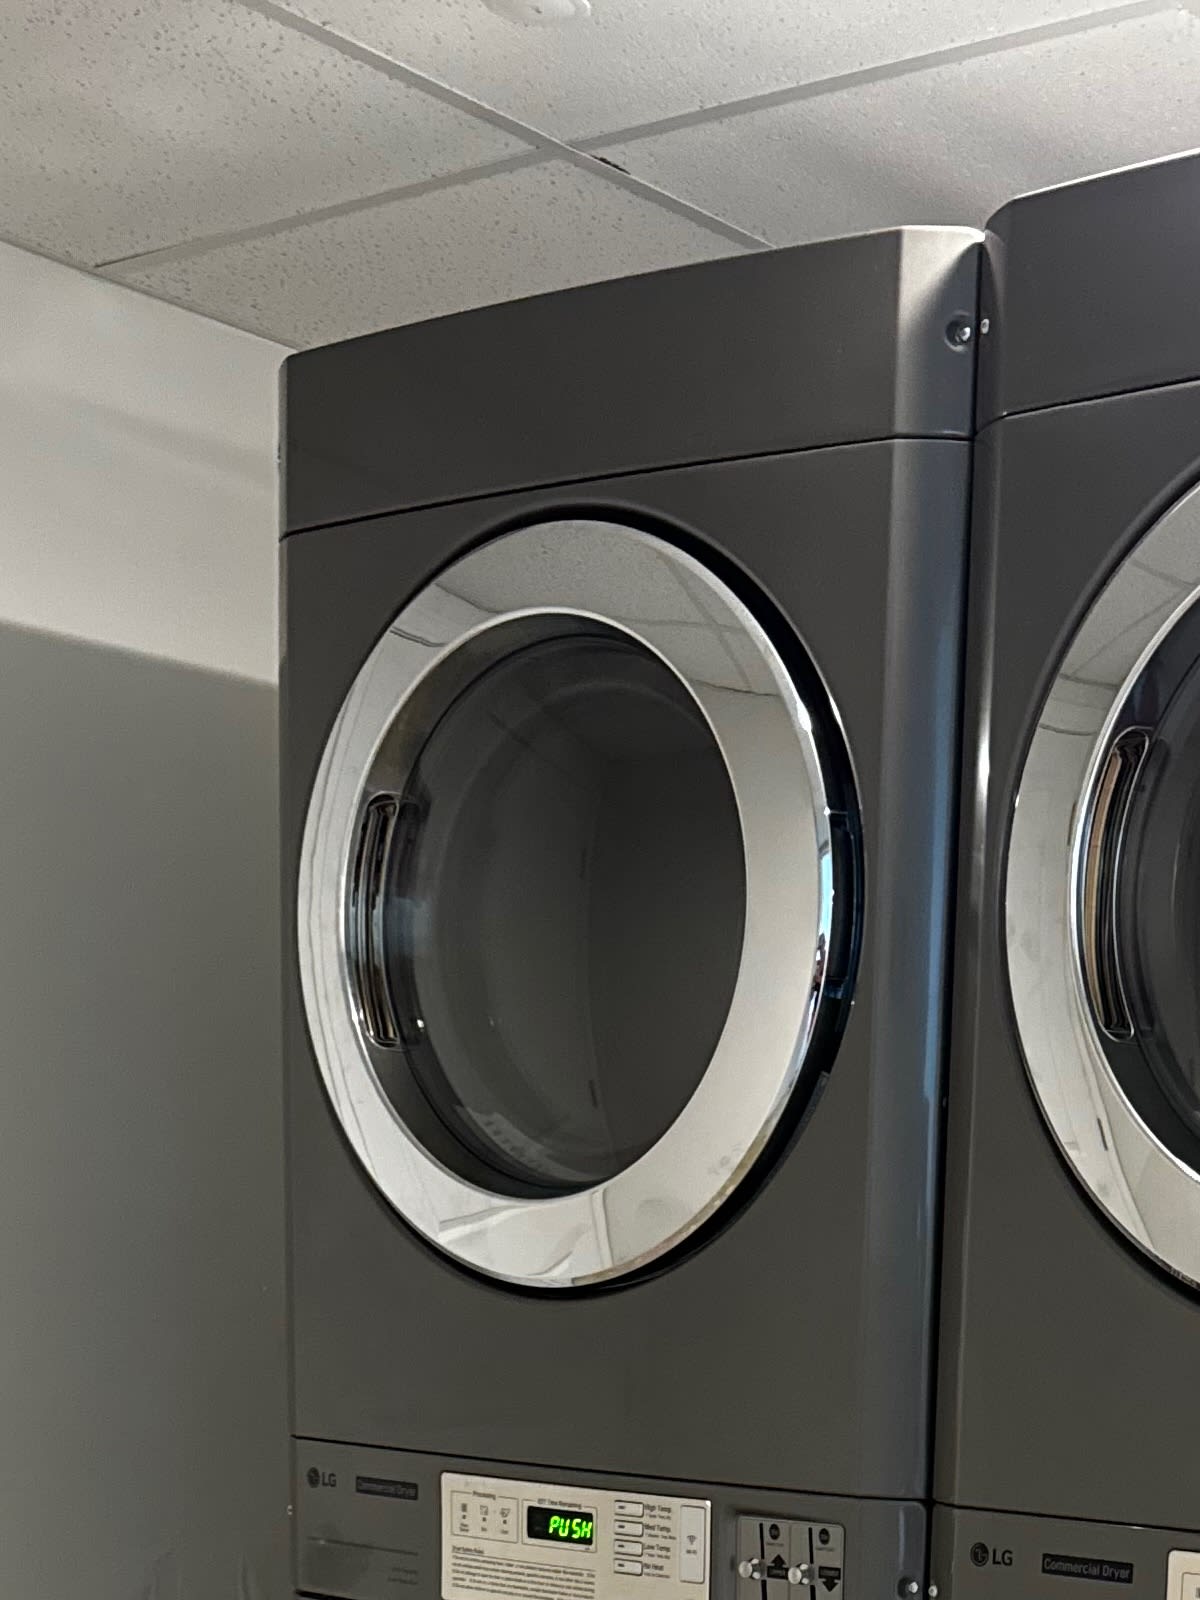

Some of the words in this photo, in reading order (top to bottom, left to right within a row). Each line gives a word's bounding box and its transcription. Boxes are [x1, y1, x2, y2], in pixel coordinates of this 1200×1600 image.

[322, 1472, 337, 1487] LG
[548, 1515, 593, 1539] PUSH
[992, 1549, 1013, 1566] LG
[1044, 1558, 1100, 1576] Commercial
[1102, 1564, 1131, 1580] Dryer
